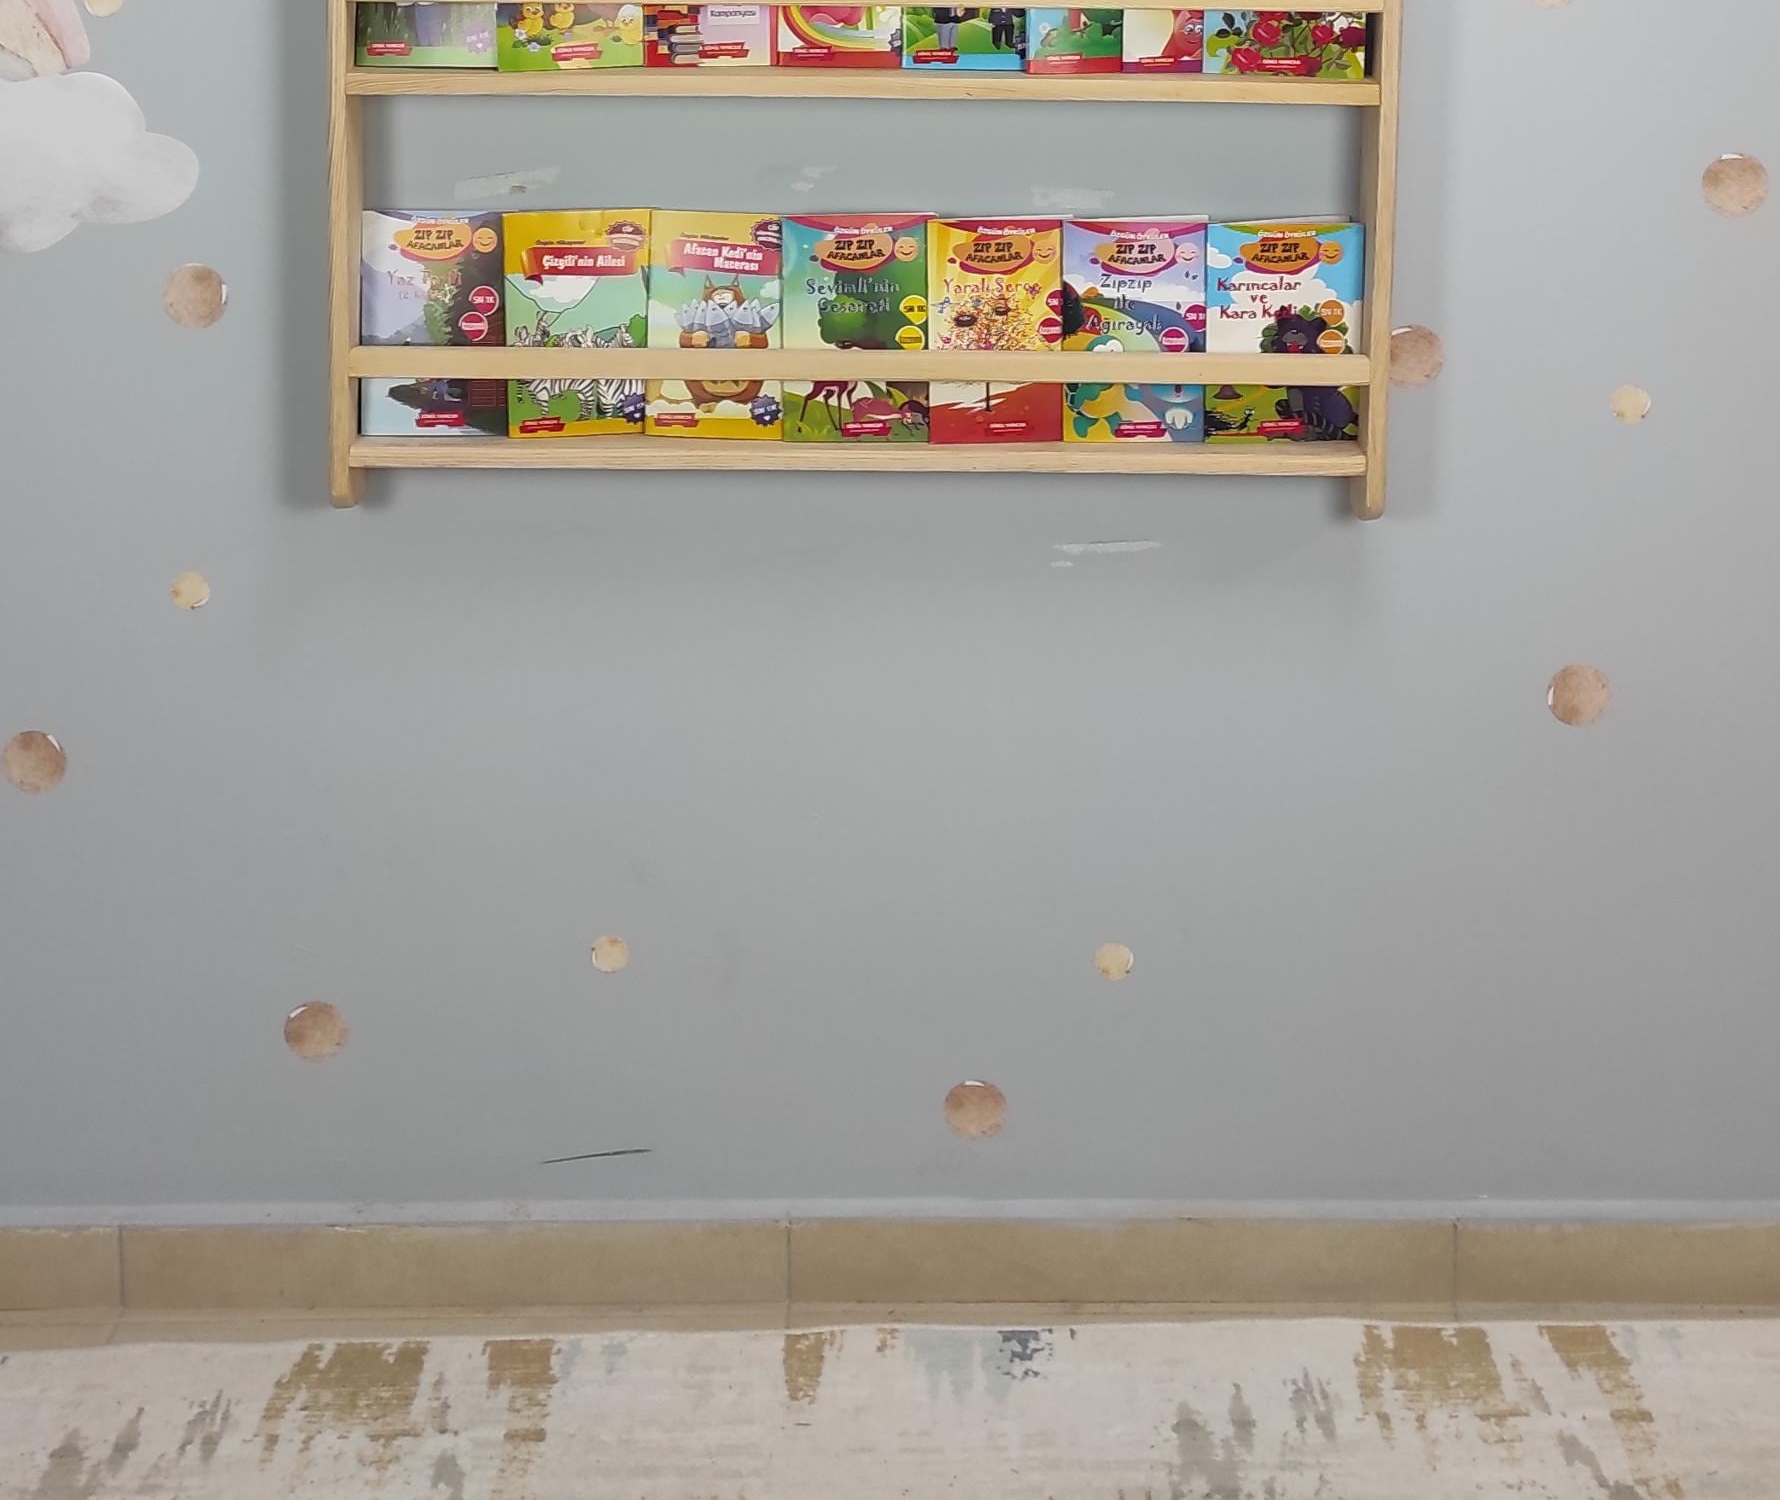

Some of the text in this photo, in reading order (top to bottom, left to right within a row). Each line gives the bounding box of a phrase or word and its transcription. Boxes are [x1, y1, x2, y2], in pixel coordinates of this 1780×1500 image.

[414, 230, 454, 240] ZIP ZIP
[684, 243, 718, 257] Afacan
[835, 240, 875, 250] ZIP ZIP
[973, 242, 1013, 254] ZIP ZIP
[1116, 244, 1156, 254] ZIP ZIP
[1260, 243, 1300, 253] ZIP ZIP
[596, 254, 625, 267] Ailesi
[714, 258, 758, 271] Macerası
[944, 278, 990, 294] Yaralı
[1217, 276, 1302, 292] Karıncalar
[1251, 294, 1268, 304] ve
[1220, 307, 1257, 319] Kara
